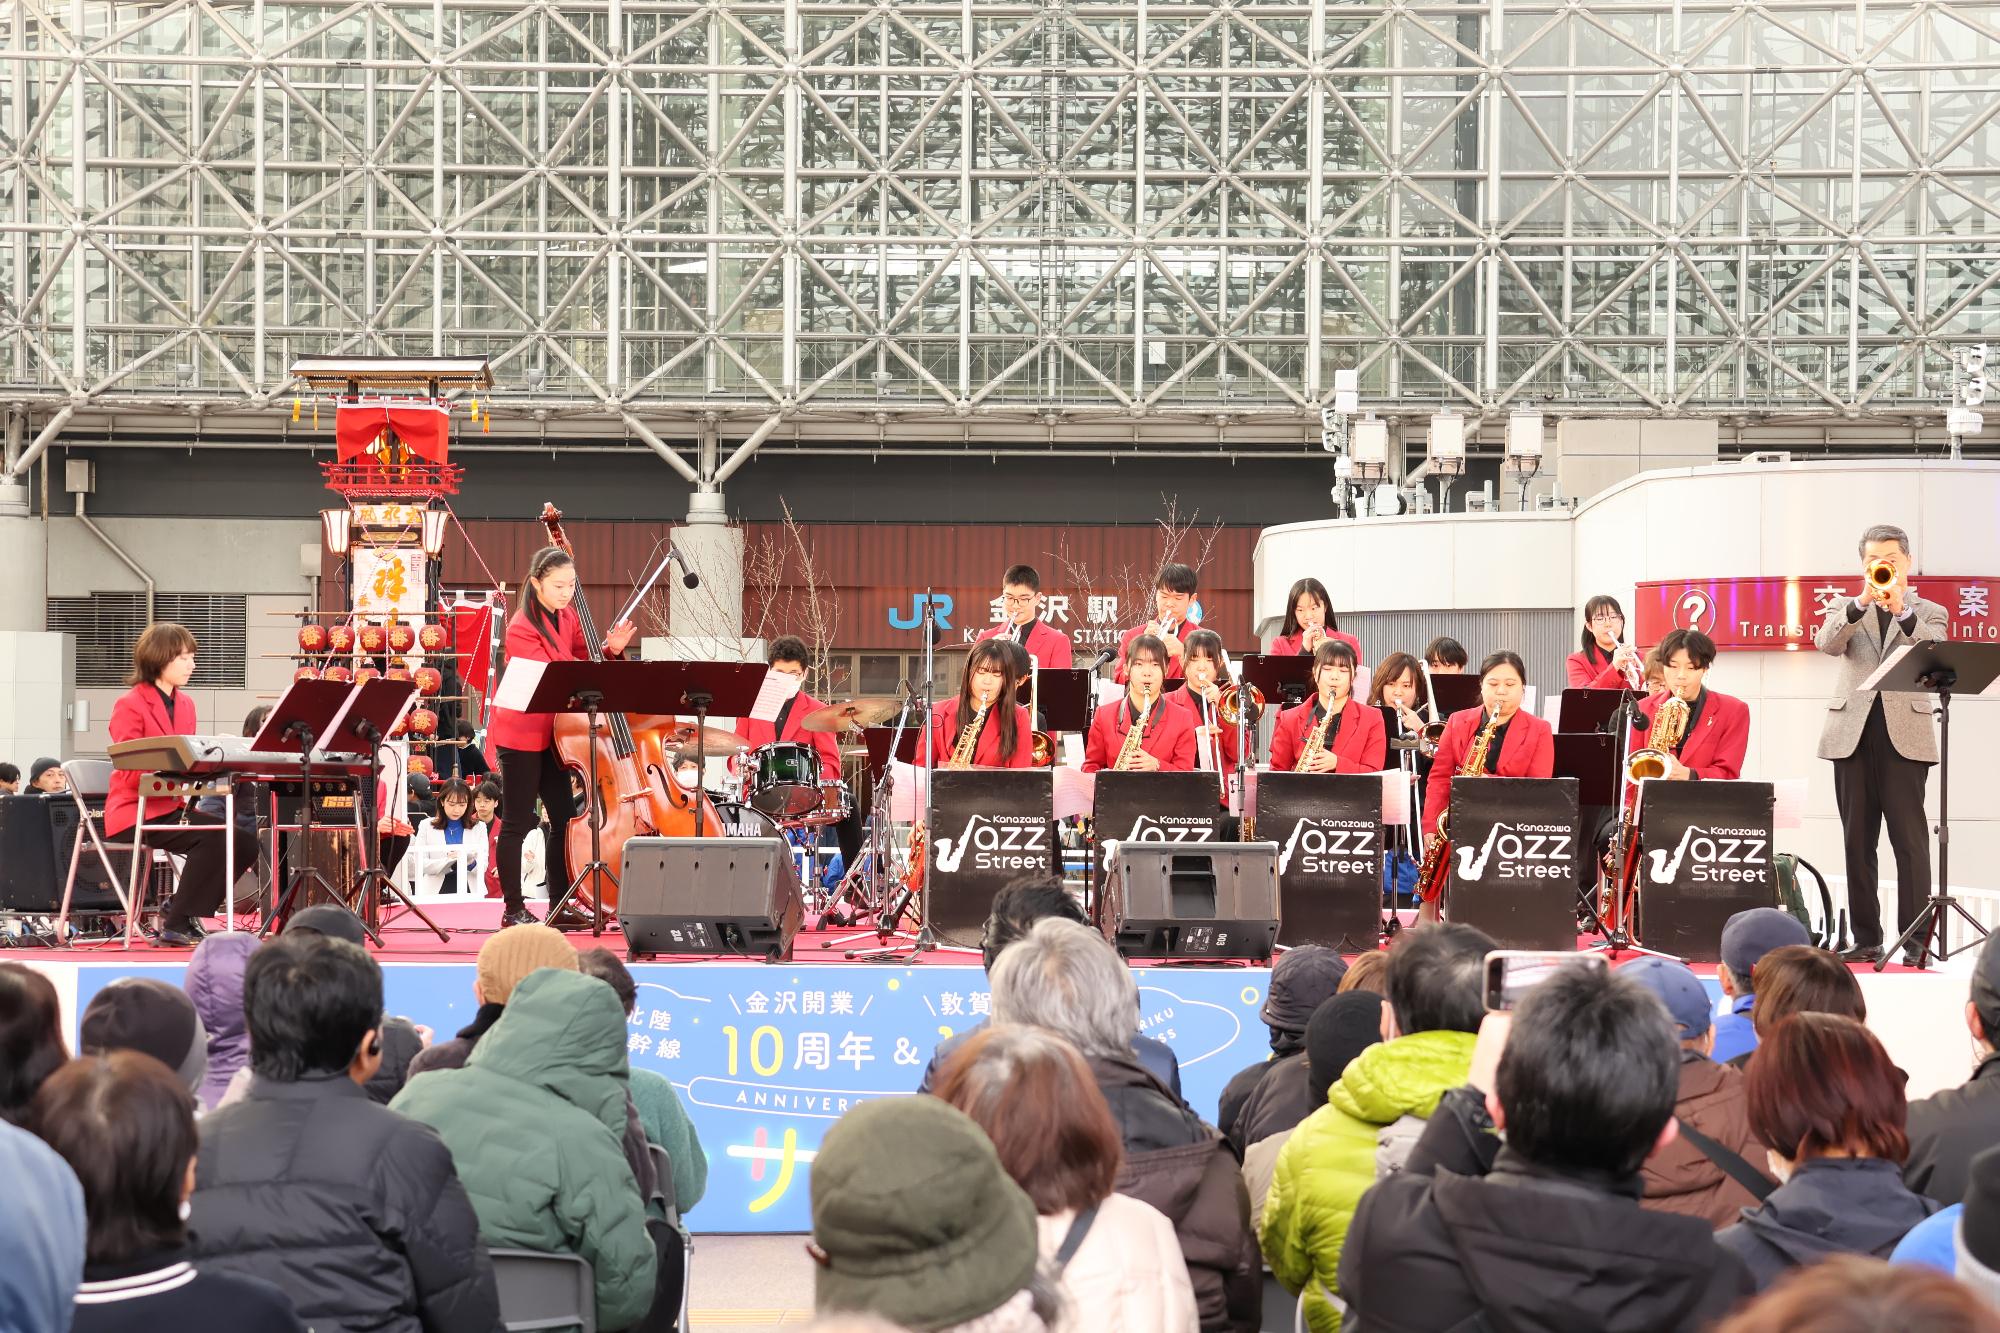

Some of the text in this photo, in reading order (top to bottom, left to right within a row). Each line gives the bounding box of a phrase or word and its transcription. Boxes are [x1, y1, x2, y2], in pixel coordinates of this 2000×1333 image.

[888, 594, 953, 630] JR
[1739, 621, 1820, 641] Transp
[992, 814, 1046, 824] Kanazawa
[1159, 815, 1213, 825] Kanazawa
[1320, 818, 1375, 828] Kanazawa
[1515, 822, 1571, 833] Kanazawa
[723, 822, 762, 836] AMAHA
[1710, 826, 1766, 837] Kanazawa
[975, 852, 1046, 869] Street
[1302, 856, 1375, 875] Street
[1498, 861, 1571, 879] Street
[1691, 864, 1766, 883] Street
[1215, 933, 1228, 946] 003
[745, 990, 854, 1015] 金沢開業
[893, 1036, 921, 1066] &
